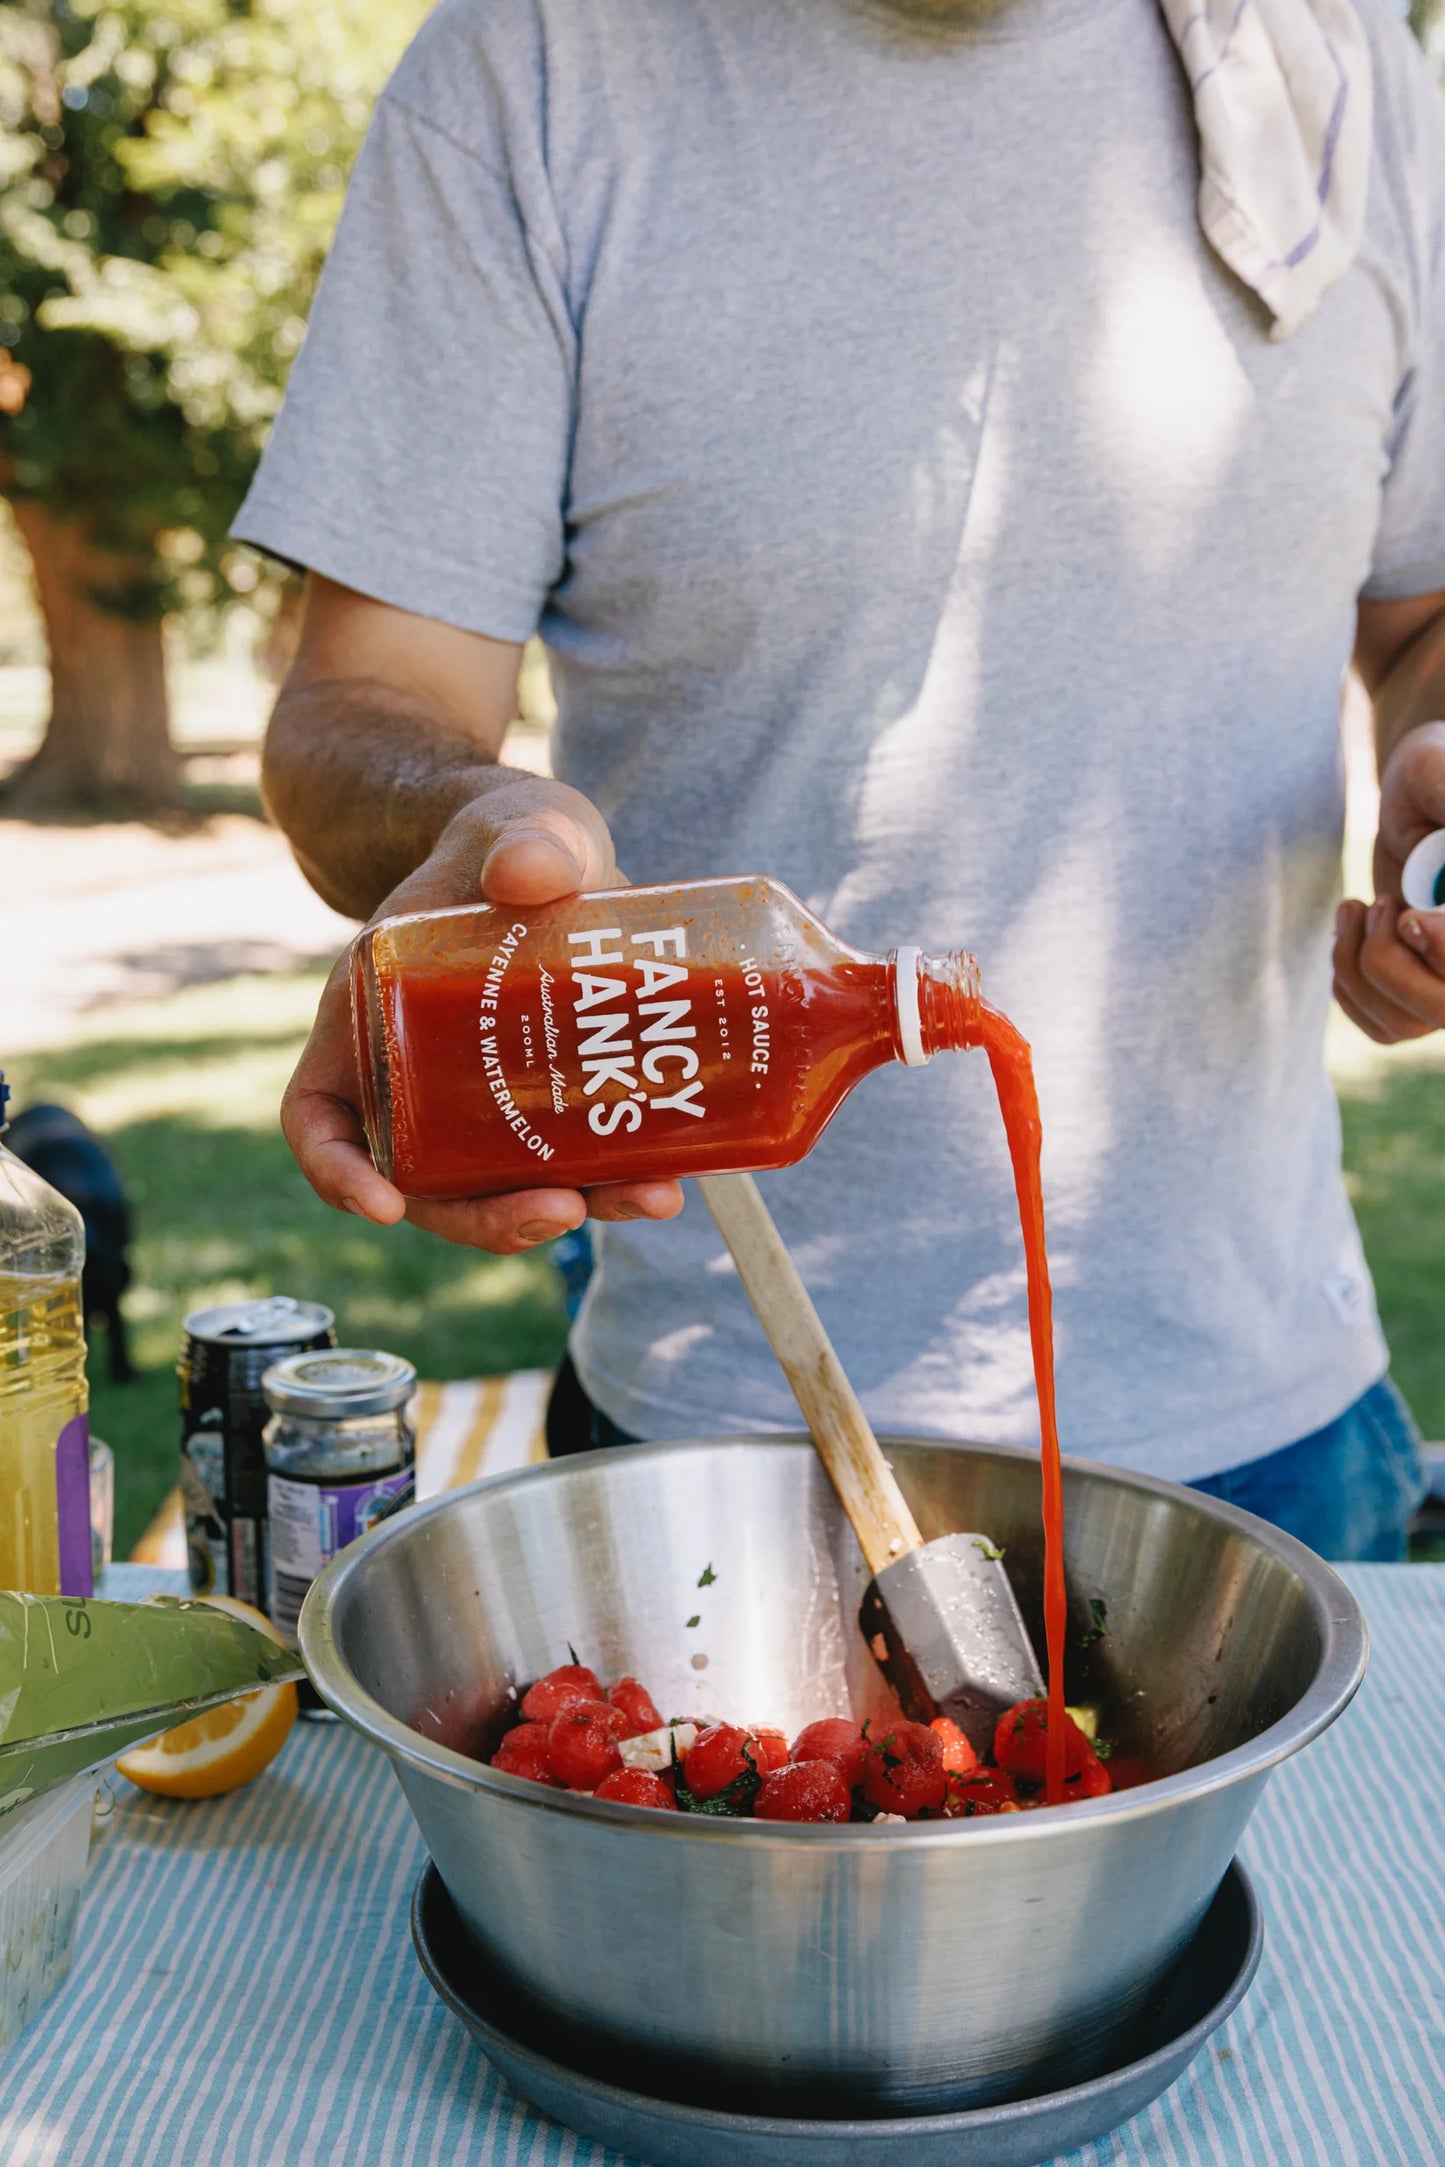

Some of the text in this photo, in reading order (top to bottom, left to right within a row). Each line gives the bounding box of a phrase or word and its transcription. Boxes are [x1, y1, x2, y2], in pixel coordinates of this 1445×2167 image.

[479, 923, 555, 1161] CAYENNE & WATERMELON
[520, 1014, 534, 1067] 200ML
[538, 963, 569, 1114] Australian Made
[567, 927, 648, 1136] HANK'S
[630, 926, 706, 1118] FANCY
[714, 979, 731, 1060] EST 2012
[739, 957, 770, 1075] HOT SAUCE
